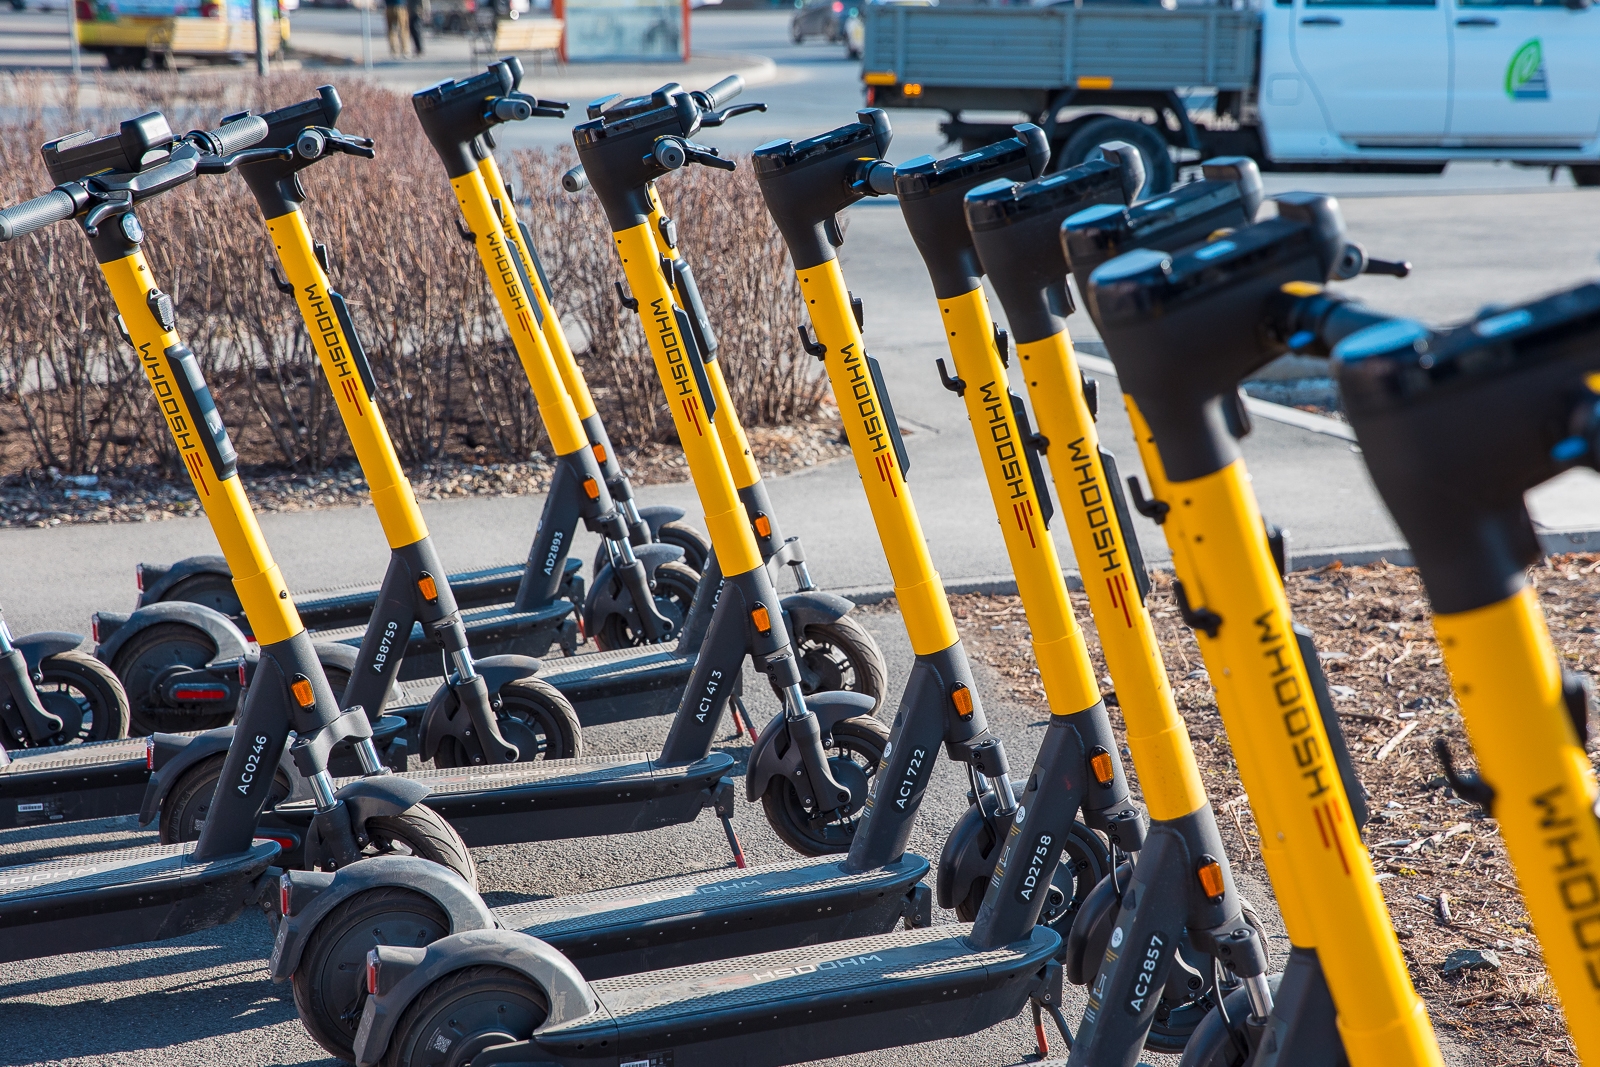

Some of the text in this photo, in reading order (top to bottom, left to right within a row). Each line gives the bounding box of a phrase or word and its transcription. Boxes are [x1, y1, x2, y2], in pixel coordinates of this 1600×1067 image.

[486, 231, 525, 310] WHOOSH
[304, 283, 352, 377] WHOOSH
[650, 297, 693, 395] WHOOSH
[139, 342, 195, 449] WHOOSH
[840, 343, 887, 452] WHOOSH
[979, 381, 1027, 499] WHOOSH
[1067, 436, 1121, 572] WHOOSH
[543, 531, 563, 576] AD2893
[373, 621, 398, 673] AB8759
[1253, 609, 1330, 798] WHOOSH
[237, 735, 267, 795] AC0246
[1021, 835, 1052, 901] AD2758
[752, 954, 882, 981] WHOOSH
[1130, 935, 1164, 1012] AC2857
